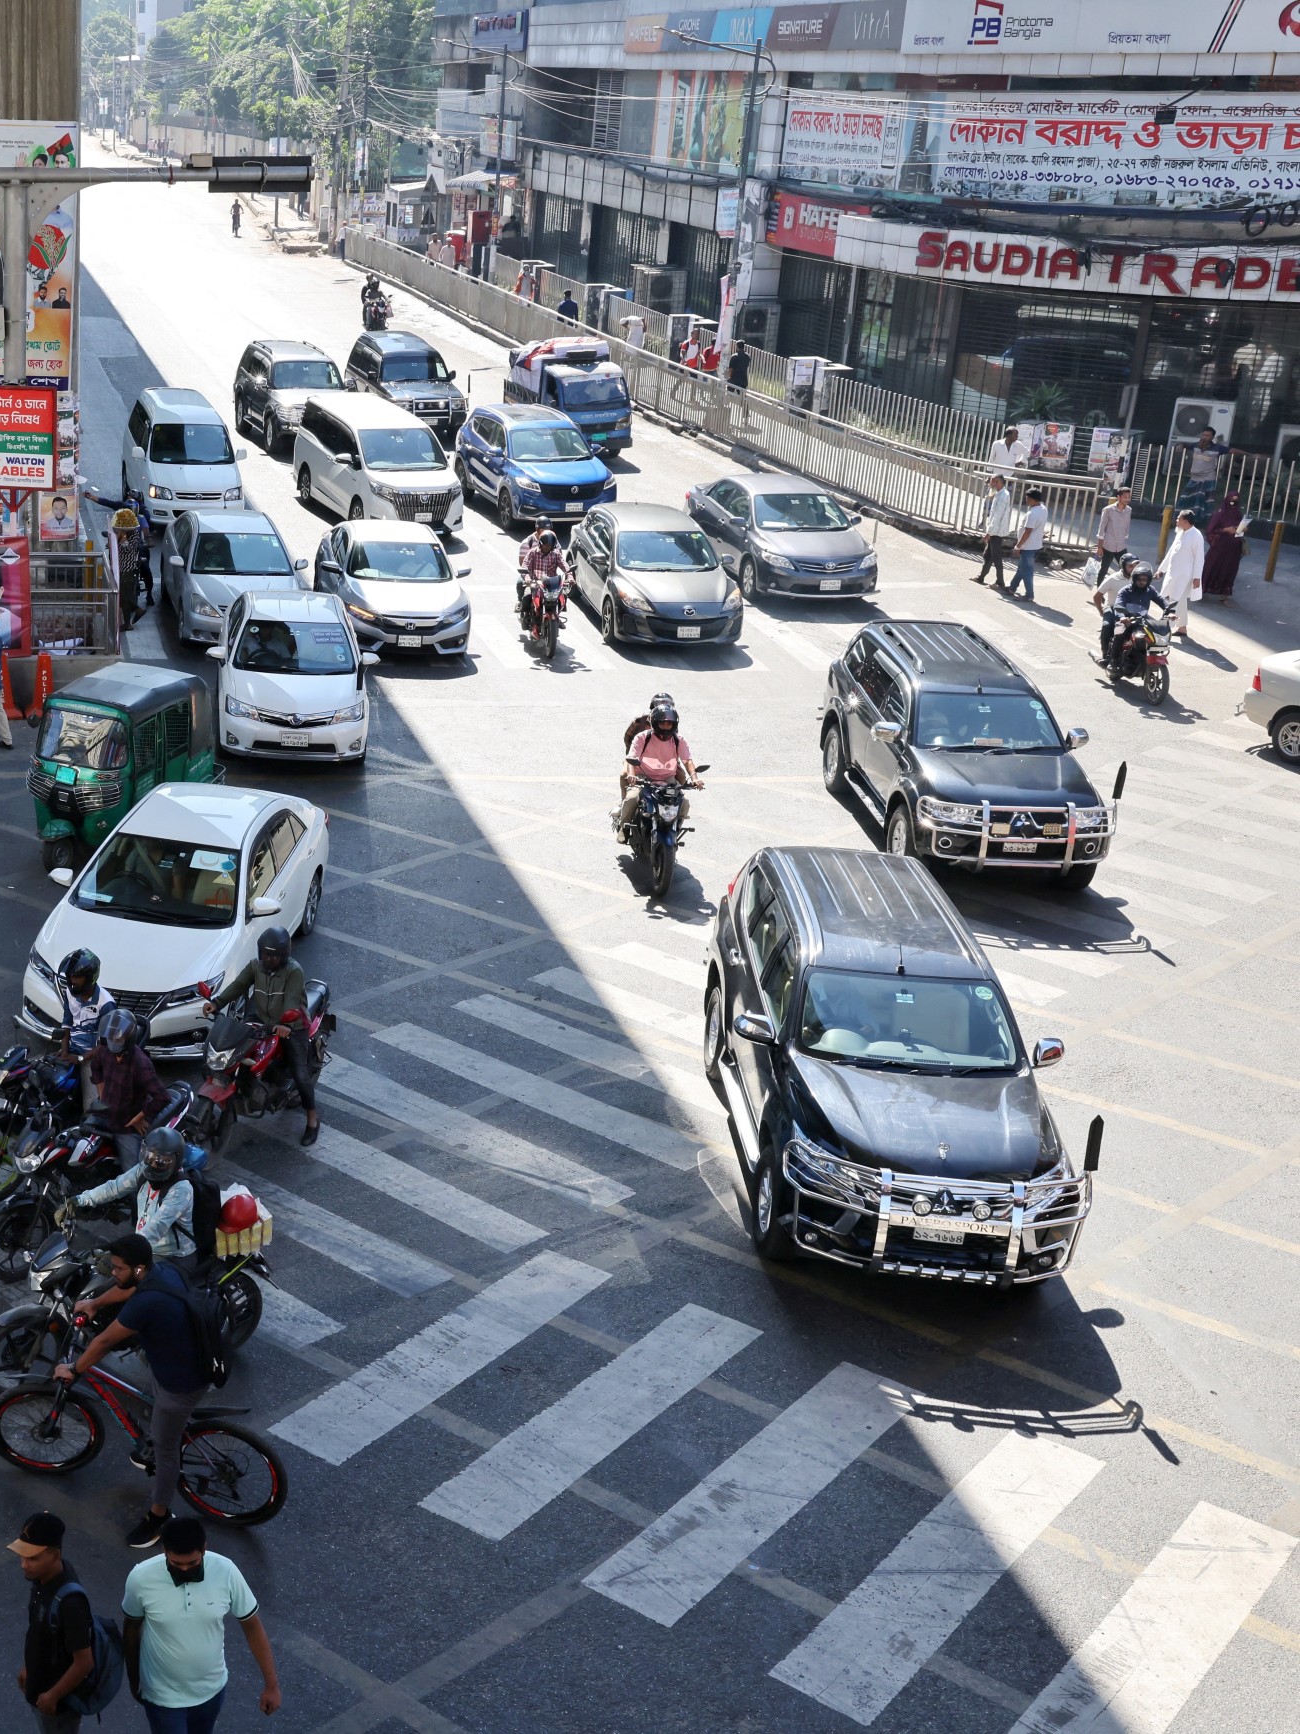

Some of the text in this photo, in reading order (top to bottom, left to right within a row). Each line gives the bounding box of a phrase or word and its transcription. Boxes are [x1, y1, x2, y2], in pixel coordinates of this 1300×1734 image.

[678, 17, 701, 31] GROHE
[777, 19, 823, 35] SIGNATURE
[853, 9, 890, 40] VitrA
[1005, 15, 1054, 28] Priotoma
[730, 16, 754, 43] INAX
[1004, 27, 1041, 40] Bangla
[1108, 32, 1171, 45] প্রিয়তমা বাংলা
[1026, 99, 1073, 115] মোবাইল
[1077, 99, 1120, 115] মার্কেট
[789, 110, 813, 132] দোকান
[814, 111, 835, 136] বরাদ্দ
[842, 113, 861, 139] ভাড়া
[861, 114, 885, 141] চলছে
[950, 118, 1028, 145] দোকান
[1035, 120, 1127, 150] বরাদ্দ
[1133, 121, 1161, 149] ও
[1175, 122, 1274, 155] ভাড়া
[1052, 156, 1073, 166] রহমান
[1107, 158, 1136, 170] ২৫-২৭
[1140, 154, 1161, 170] কাজী
[1164, 159, 1194, 171] নজরুল
[1197, 157, 1229, 171] ইসলাম
[944, 165, 987, 180] যোগাযোগ:
[915, 231, 1082, 281] SAUDIA
[43, 340, 61, 353] ভোট
[27, 360, 44, 371] জন্য
[45, 359, 63, 371] হোক
[30, 377, 61, 386] শেখ
[14, 400, 22, 409] ও
[24, 399, 47, 409] ডানে
[11, 411, 40, 425] নিষেধ
[17, 435, 31, 443] রমনা
[32, 435, 48, 443] বিভাগ
[6, 457, 45, 466] WALTON
[954, 1221, 998, 1233] SPORT
[914, 1231, 963, 1243] ১২-৭৬৬৪
